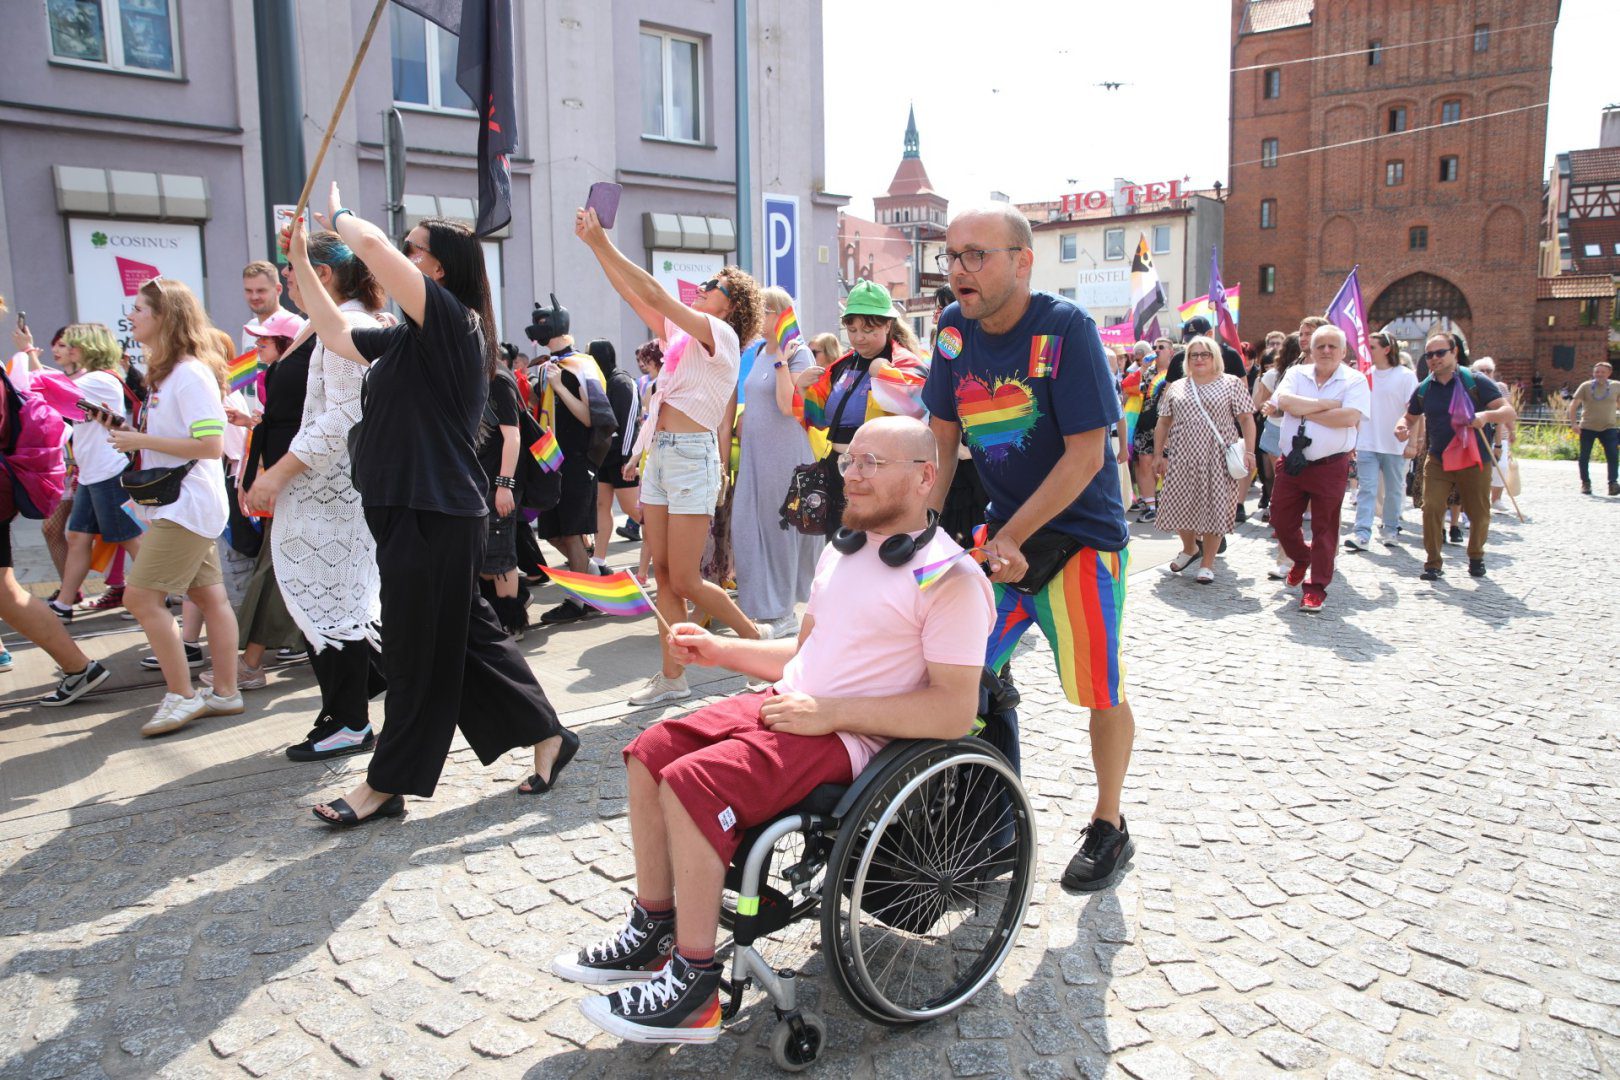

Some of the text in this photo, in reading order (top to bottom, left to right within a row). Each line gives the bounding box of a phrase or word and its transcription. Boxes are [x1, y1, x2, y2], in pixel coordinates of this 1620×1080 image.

[110, 235, 178, 248] COSINUS
[769, 212, 792, 288] P
[673, 263, 712, 273] COSINUS
[1080, 270, 1129, 284] HOSTEL
